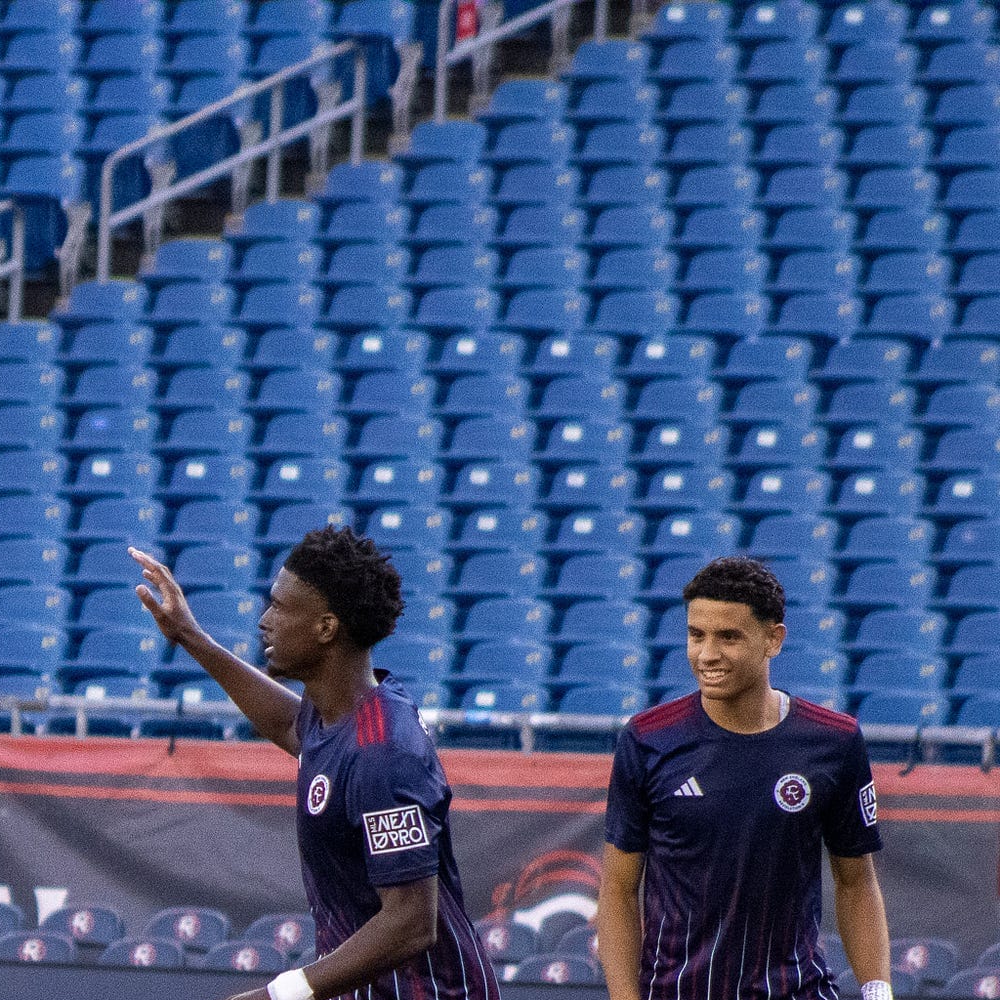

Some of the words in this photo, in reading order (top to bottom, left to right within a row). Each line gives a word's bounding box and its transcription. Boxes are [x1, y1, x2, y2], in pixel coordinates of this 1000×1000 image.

[367, 816, 378, 833] MLS
[377, 809, 417, 832] NEXT
[387, 826, 423, 847] PRO
